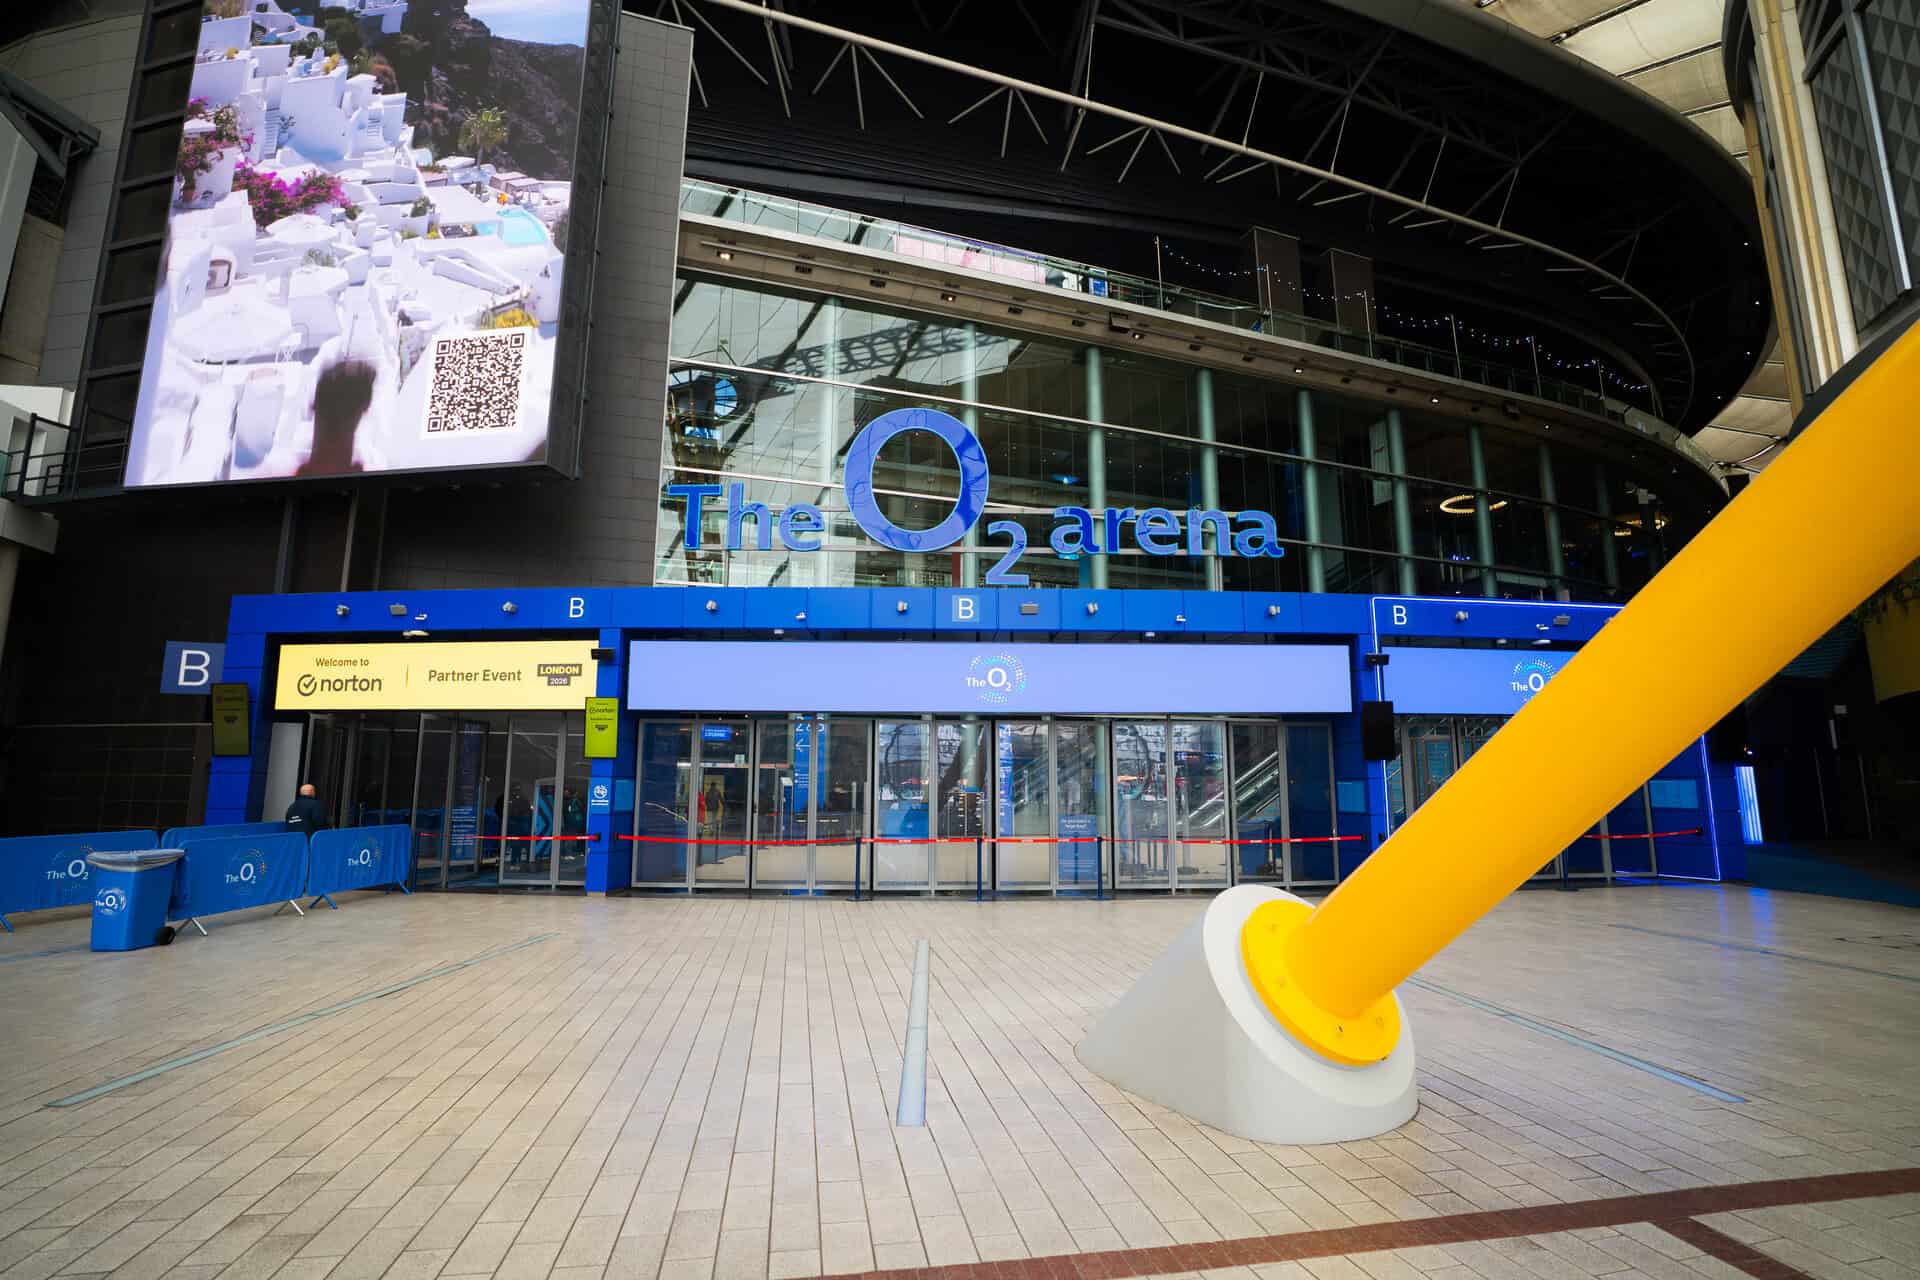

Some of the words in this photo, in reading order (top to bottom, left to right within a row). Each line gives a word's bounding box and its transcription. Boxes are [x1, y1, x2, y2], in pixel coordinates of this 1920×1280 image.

[667, 481, 824, 552] The
[1049, 505, 1285, 558] arena
[569, 597, 585, 618] B
[958, 597, 975, 619] B
[1393, 604, 1408, 625] B
[178, 649, 211, 686] B
[315, 657, 358, 667] Welcome
[360, 657, 369, 667] to
[428, 668, 479, 683] Partner
[482, 668, 522, 682] Event
[540, 665, 579, 674] LONDON
[320, 674, 382, 693] norton
[967, 677, 986, 687] The
[1512, 682, 1529, 692] The
[347, 858, 360, 867] The
[47, 870, 67, 880] The
[225, 873, 239, 884] The
